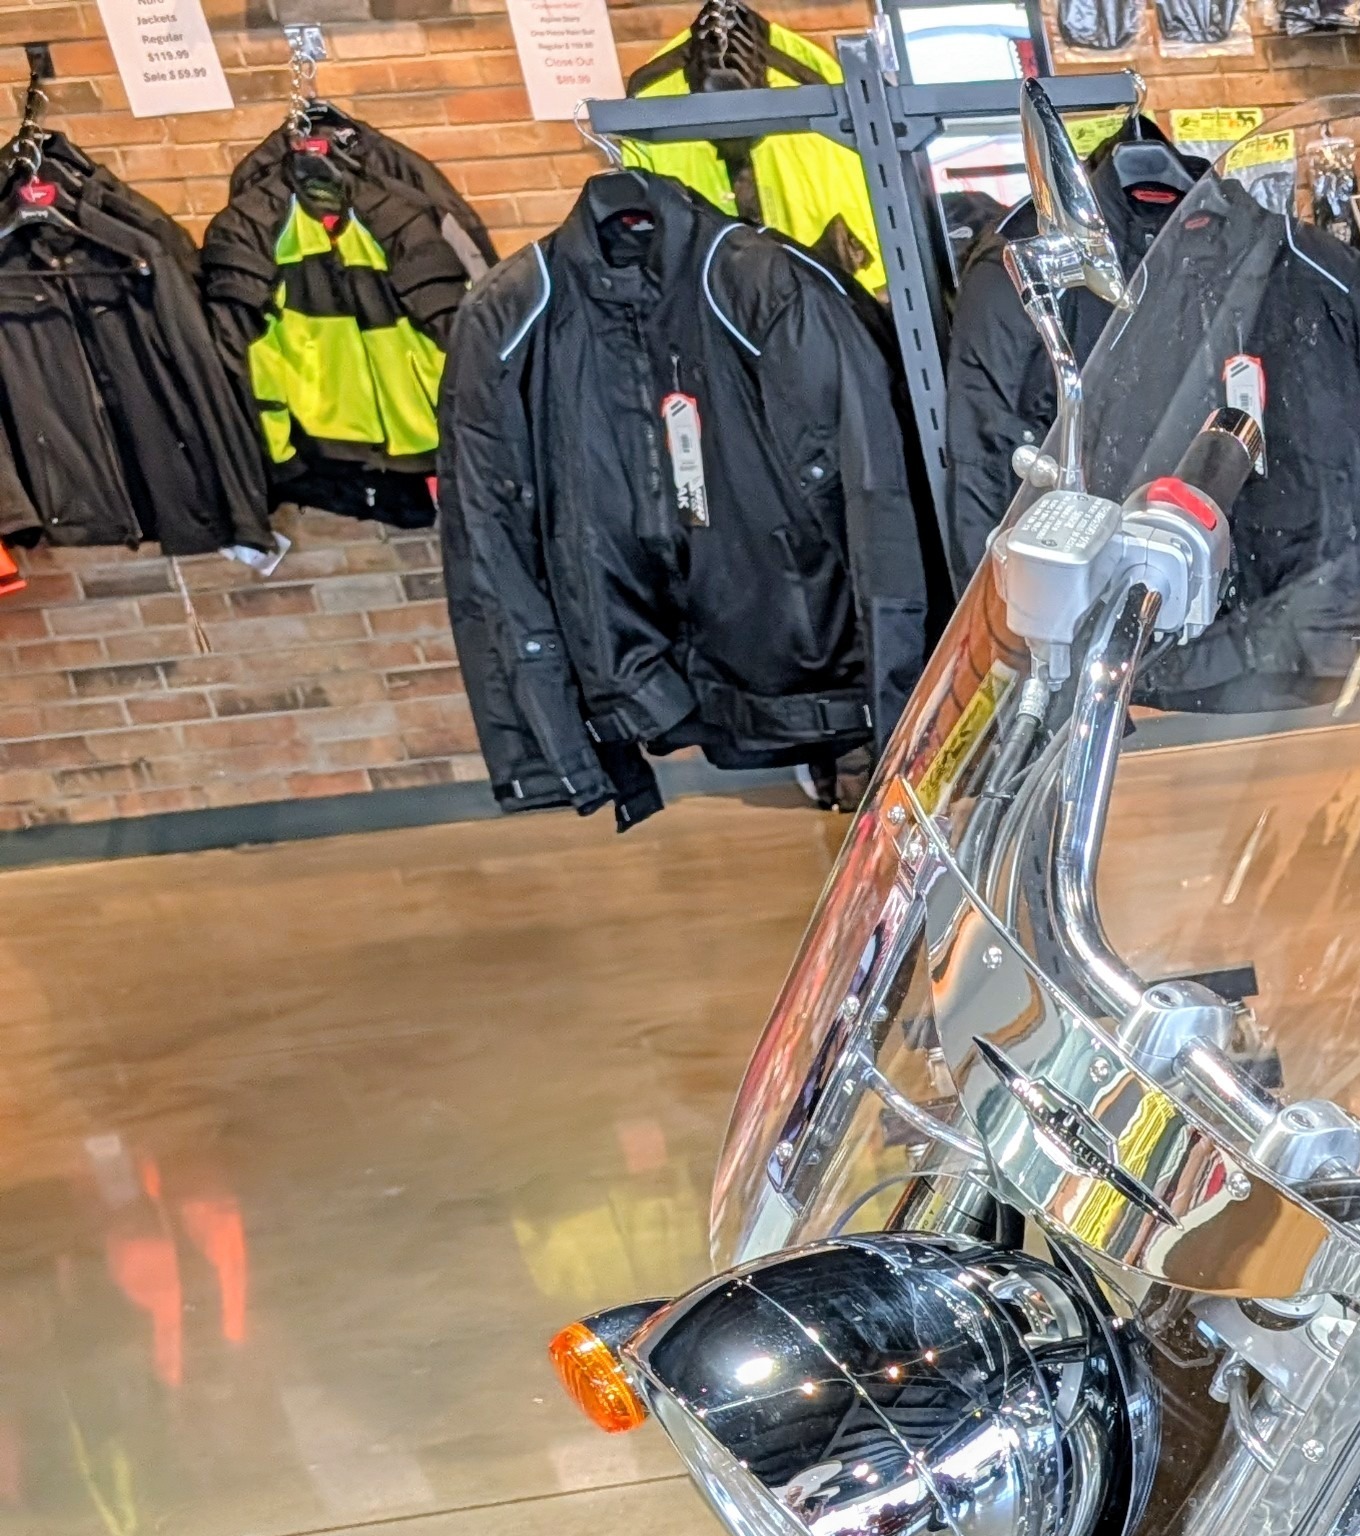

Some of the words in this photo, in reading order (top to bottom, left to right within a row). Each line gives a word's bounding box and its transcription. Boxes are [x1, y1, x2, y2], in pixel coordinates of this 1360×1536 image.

[137, 14, 178, 25] Jackets
[142, 33, 184, 45] Regular
[143, 72, 167, 83] Sale
